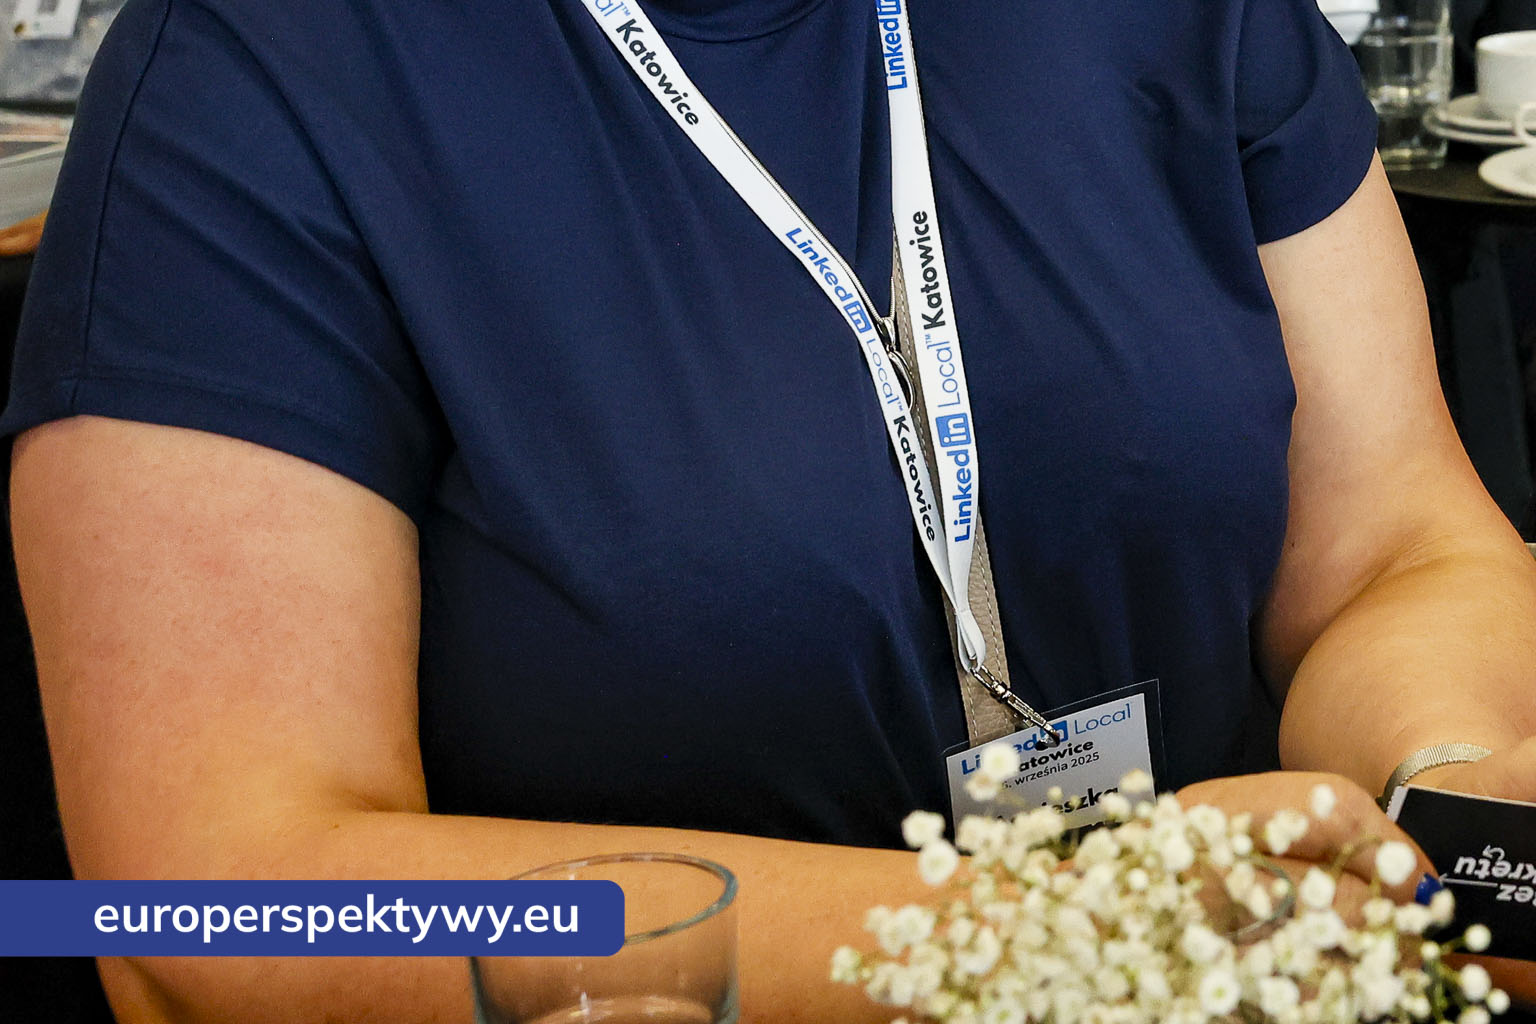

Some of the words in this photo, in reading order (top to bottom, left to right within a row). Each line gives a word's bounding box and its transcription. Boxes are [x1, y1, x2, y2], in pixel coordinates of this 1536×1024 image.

[616, 18, 699, 126] Katowice
[910, 210, 946, 330] Katowice
[894, 414, 935, 543] Katowice
[1074, 703, 1131, 734] Local
[1015, 762, 1069, 786] września
[1070, 751, 1101, 768] 2025
[1019, 739, 1094, 772] atowice
